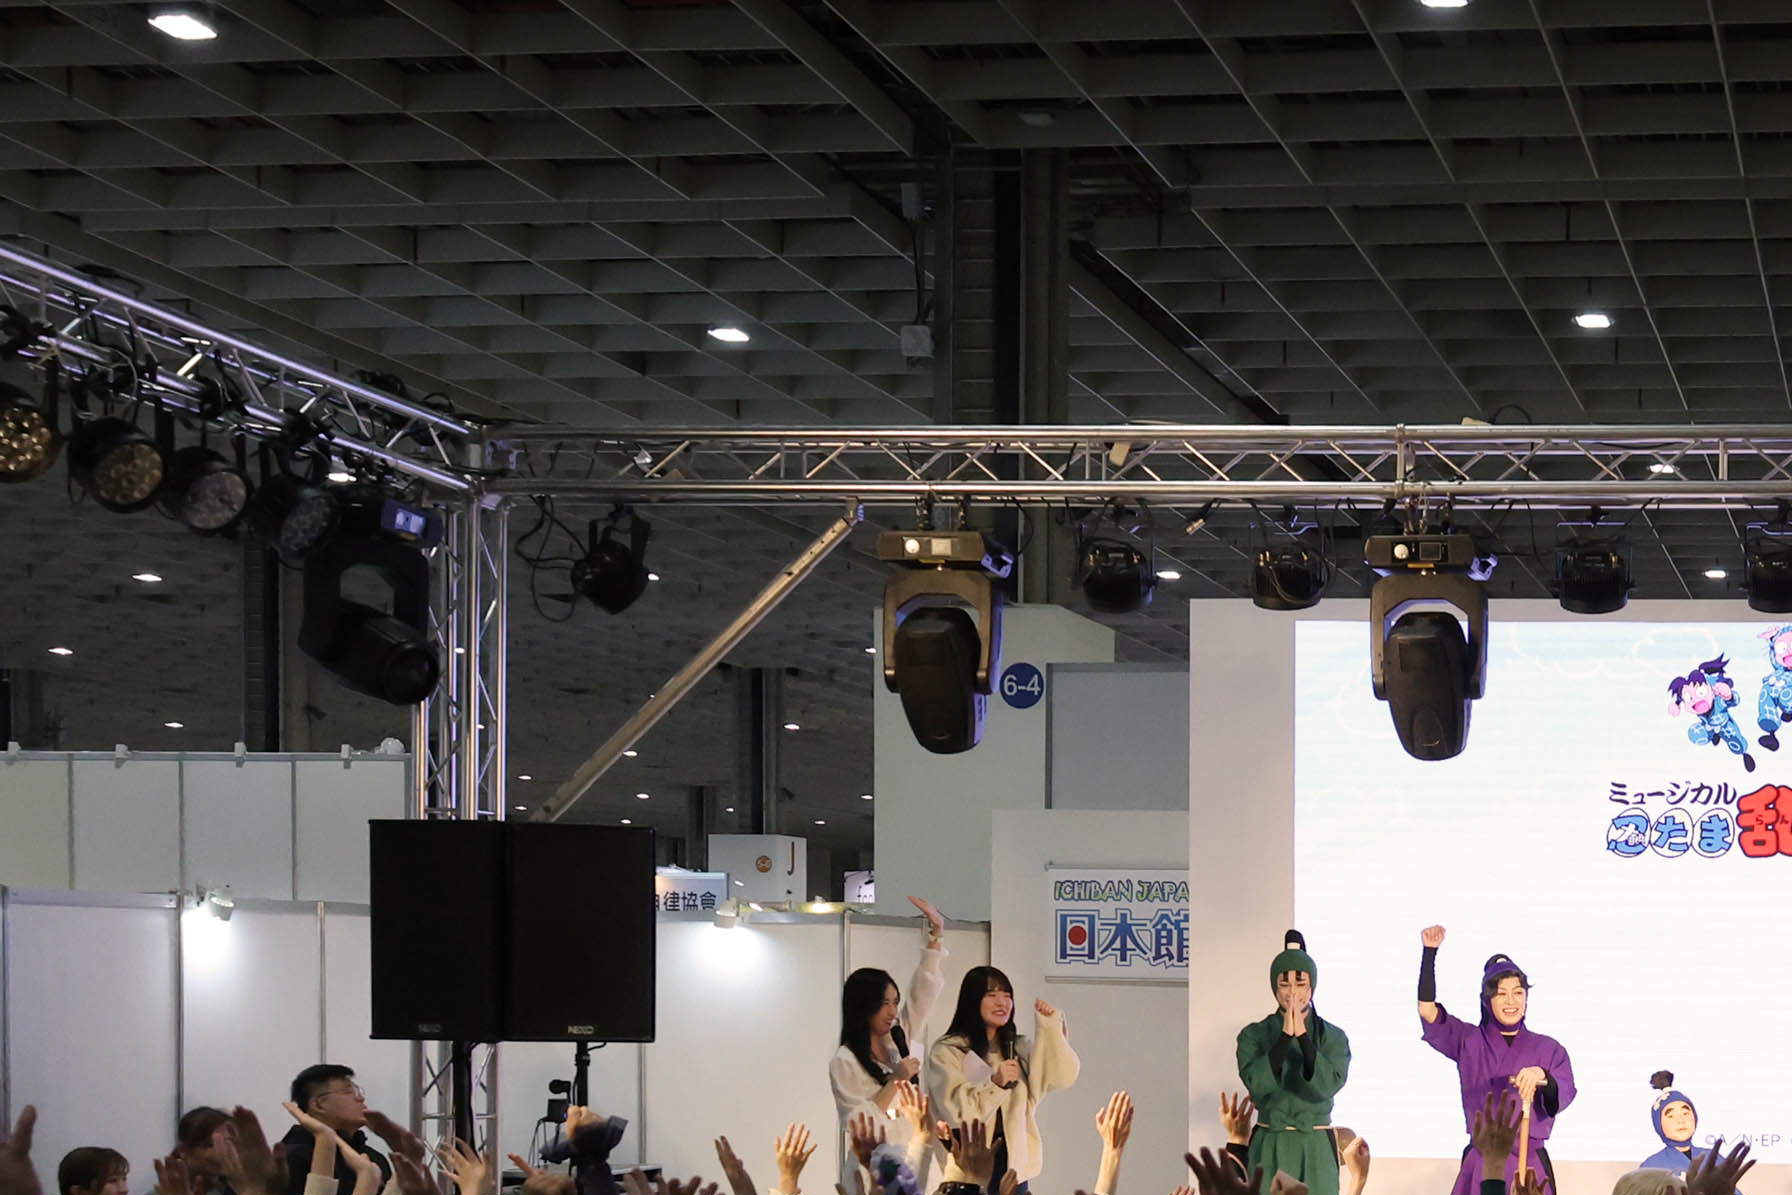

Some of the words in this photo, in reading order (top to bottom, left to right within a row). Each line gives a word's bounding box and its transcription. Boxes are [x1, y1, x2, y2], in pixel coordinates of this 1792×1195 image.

[1003, 674, 1041, 696] 6-4
[1608, 781, 1737, 806] ミュージカル
[1054, 880, 1133, 902] ICHIBAN
[1055, 908, 1189, 968] 日本館
